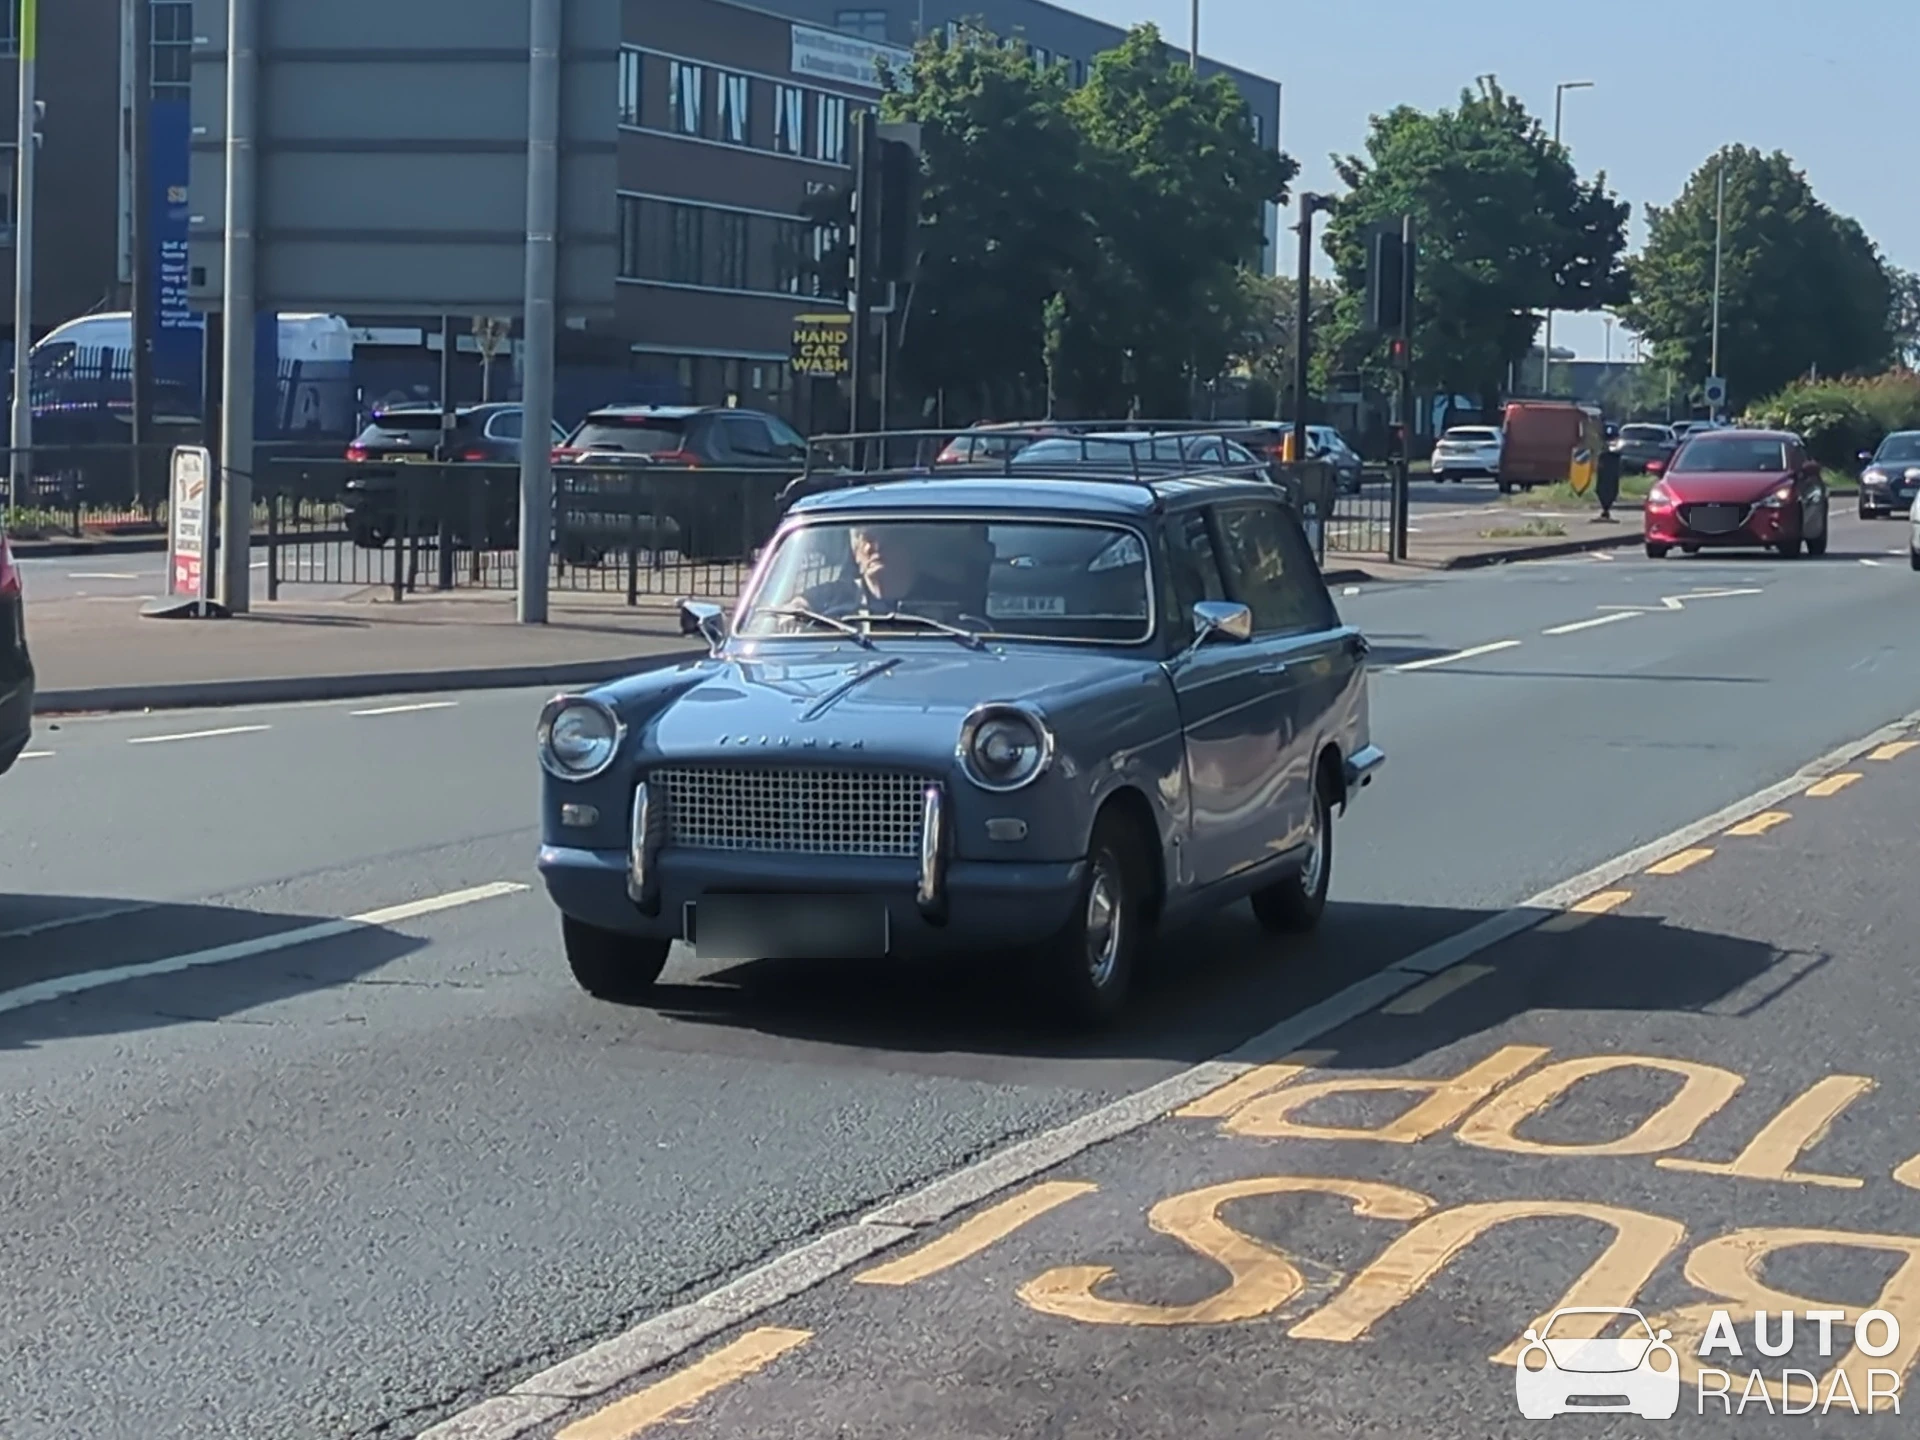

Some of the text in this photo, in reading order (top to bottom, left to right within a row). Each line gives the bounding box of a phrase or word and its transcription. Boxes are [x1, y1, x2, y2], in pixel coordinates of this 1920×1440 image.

[793, 330, 848, 343] HAND
[801, 345, 840, 357] CAR
[792, 358, 848, 371] WASH
[1222, 1045, 1920, 1188] TOP
[1015, 1176, 1920, 1411] BUS
